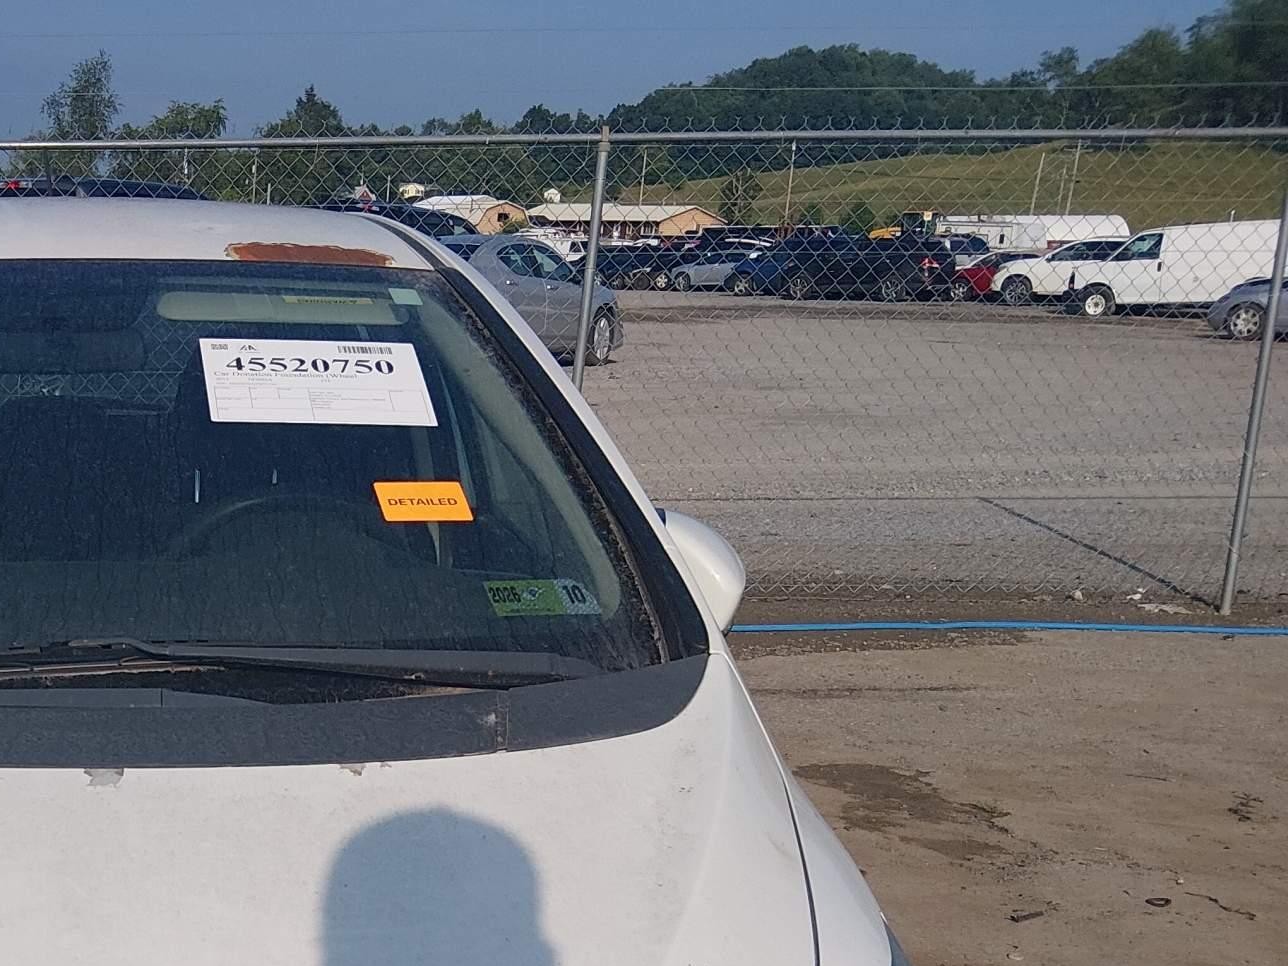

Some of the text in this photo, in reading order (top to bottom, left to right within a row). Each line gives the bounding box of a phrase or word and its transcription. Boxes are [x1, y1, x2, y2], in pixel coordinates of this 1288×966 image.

[226, 356, 394, 375] 45520750
[387, 497, 458, 506] DETAILED
[562, 584, 587, 604] 10
